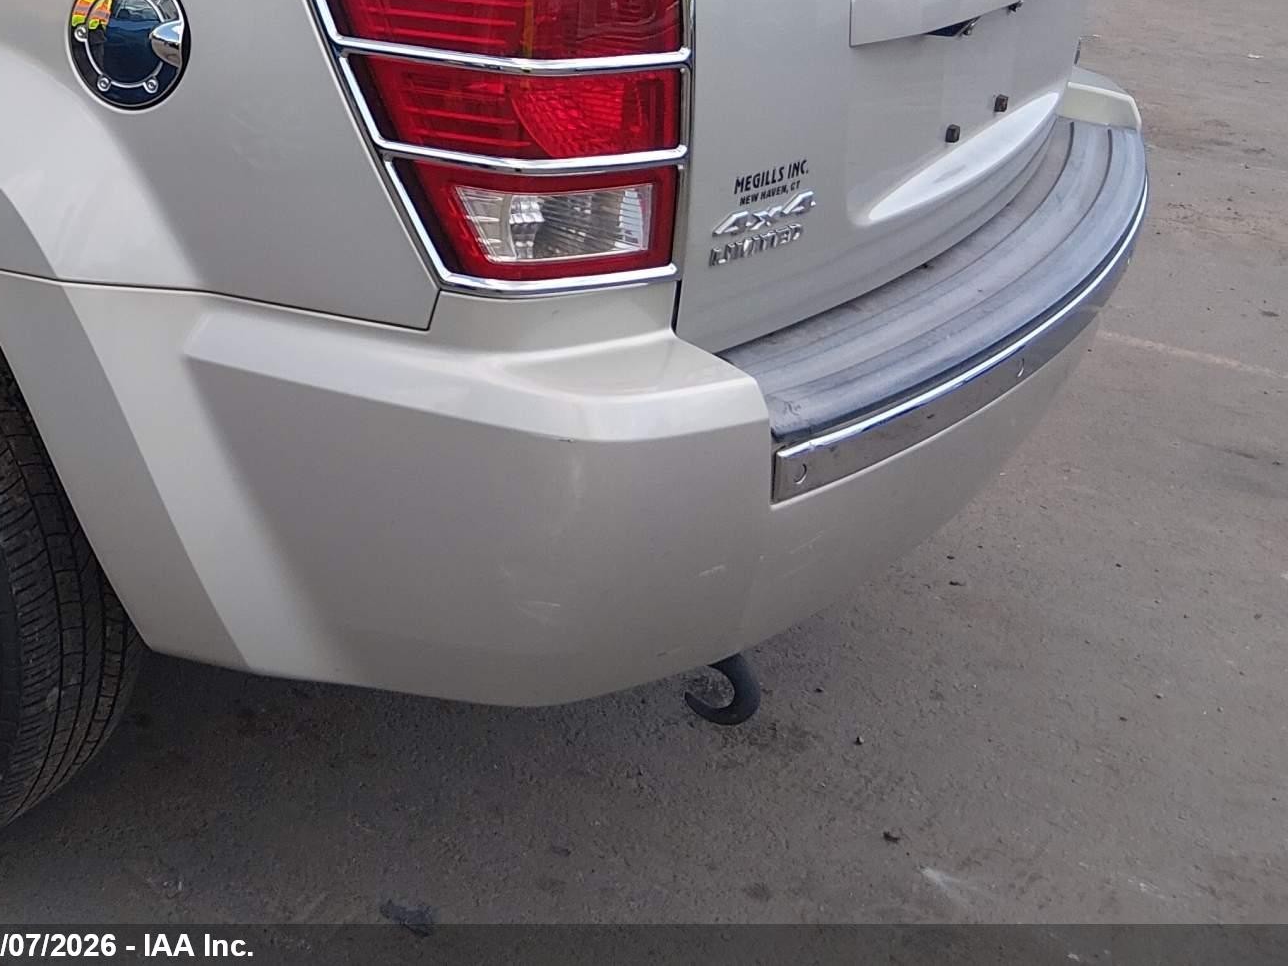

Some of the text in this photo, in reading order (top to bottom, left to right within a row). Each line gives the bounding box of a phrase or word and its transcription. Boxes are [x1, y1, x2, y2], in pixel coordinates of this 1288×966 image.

[734, 159, 809, 194] MEGILLS INC.
[739, 180, 801, 206] NEW HAVEN, CT
